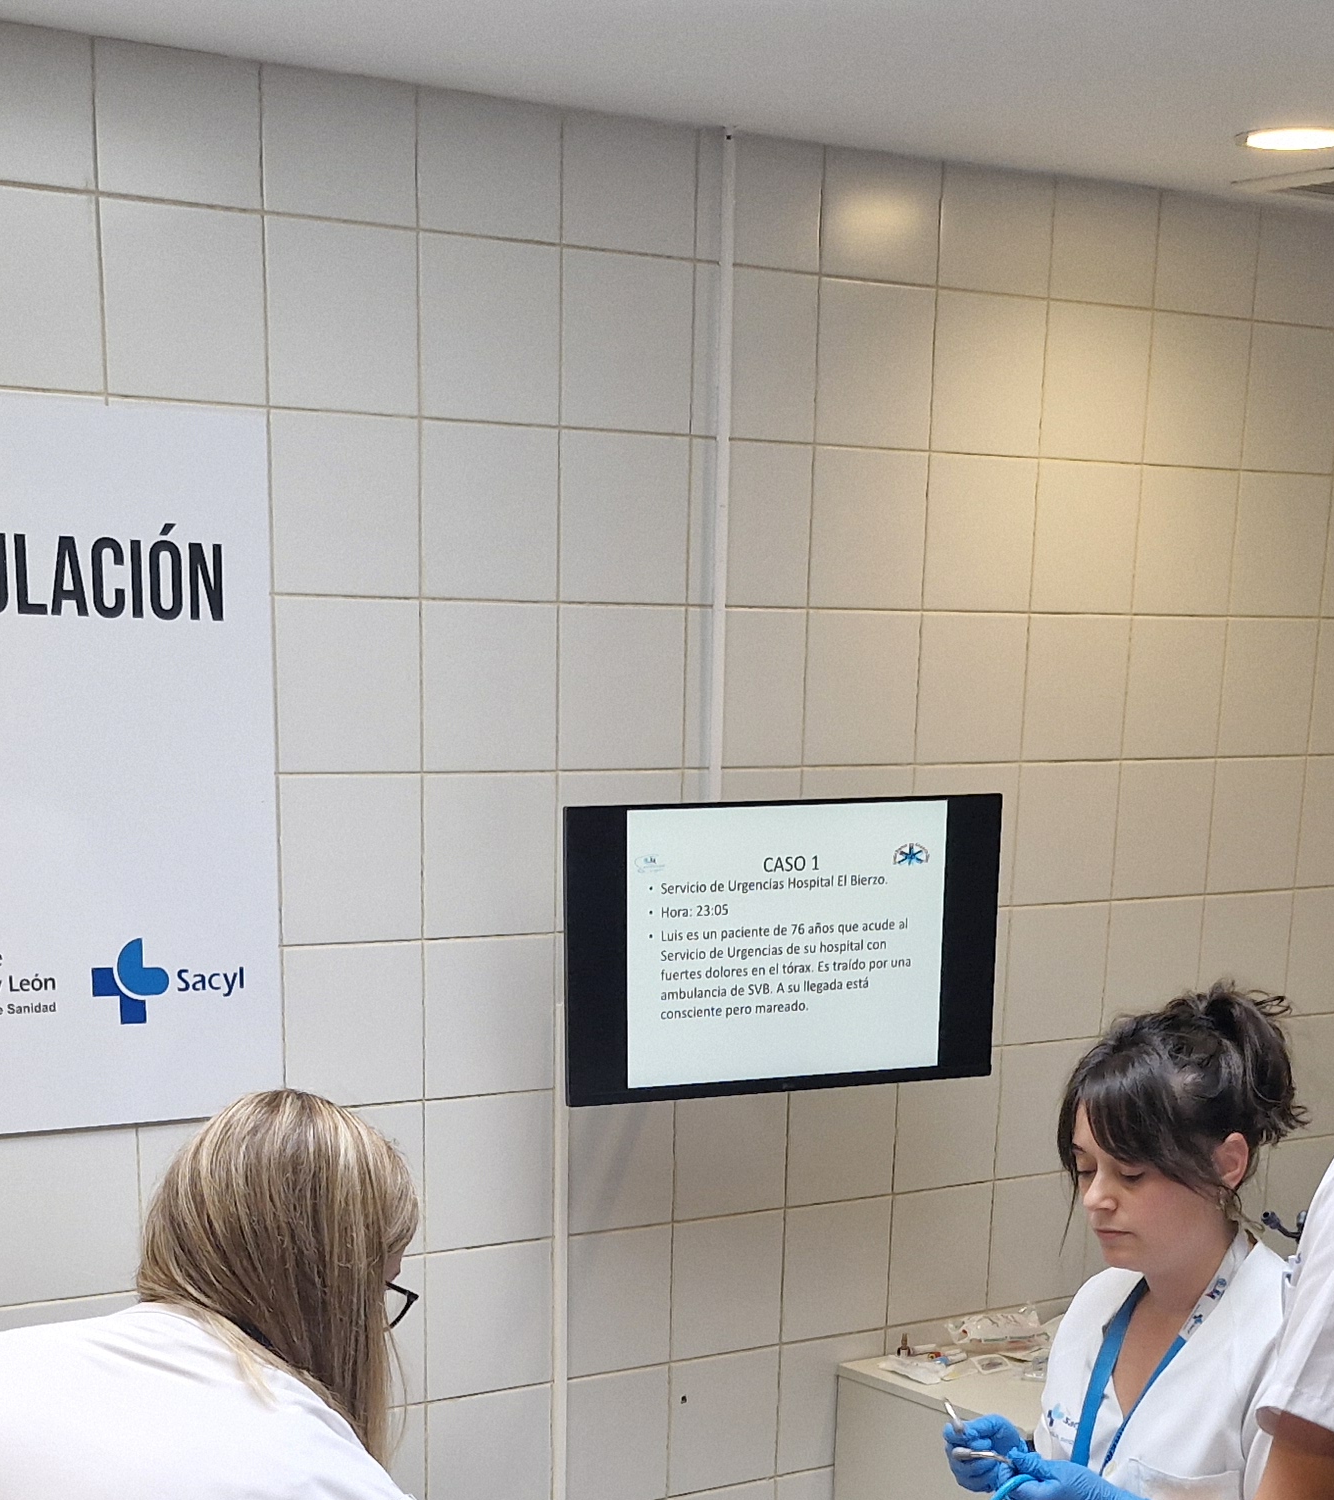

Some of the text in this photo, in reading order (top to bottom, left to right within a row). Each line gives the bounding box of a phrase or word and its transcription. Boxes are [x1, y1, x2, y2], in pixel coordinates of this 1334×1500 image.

[763, 855, 819, 872] CASO 1
[660, 873, 888, 894] Servicio de Urgencias Hospital El Bierzo.
[661, 904, 728, 918] Hora: 23:05
[661, 918, 907, 942] Luis es un paciente de 76 años que acude al
[660, 939, 886, 961] Servicio de Urgencias de su hospital con
[660, 958, 911, 981] fuertes dolores en el tórax. Es traído por una
[8, 973, 57, 994] León
[176, 966, 245, 997] Sacyl
[660, 977, 868, 1000] ambulancia de SVB. A su llegada está
[7, 1001, 57, 1015] Sanidad
[660, 1000, 808, 1020] consciente pero mareado.
